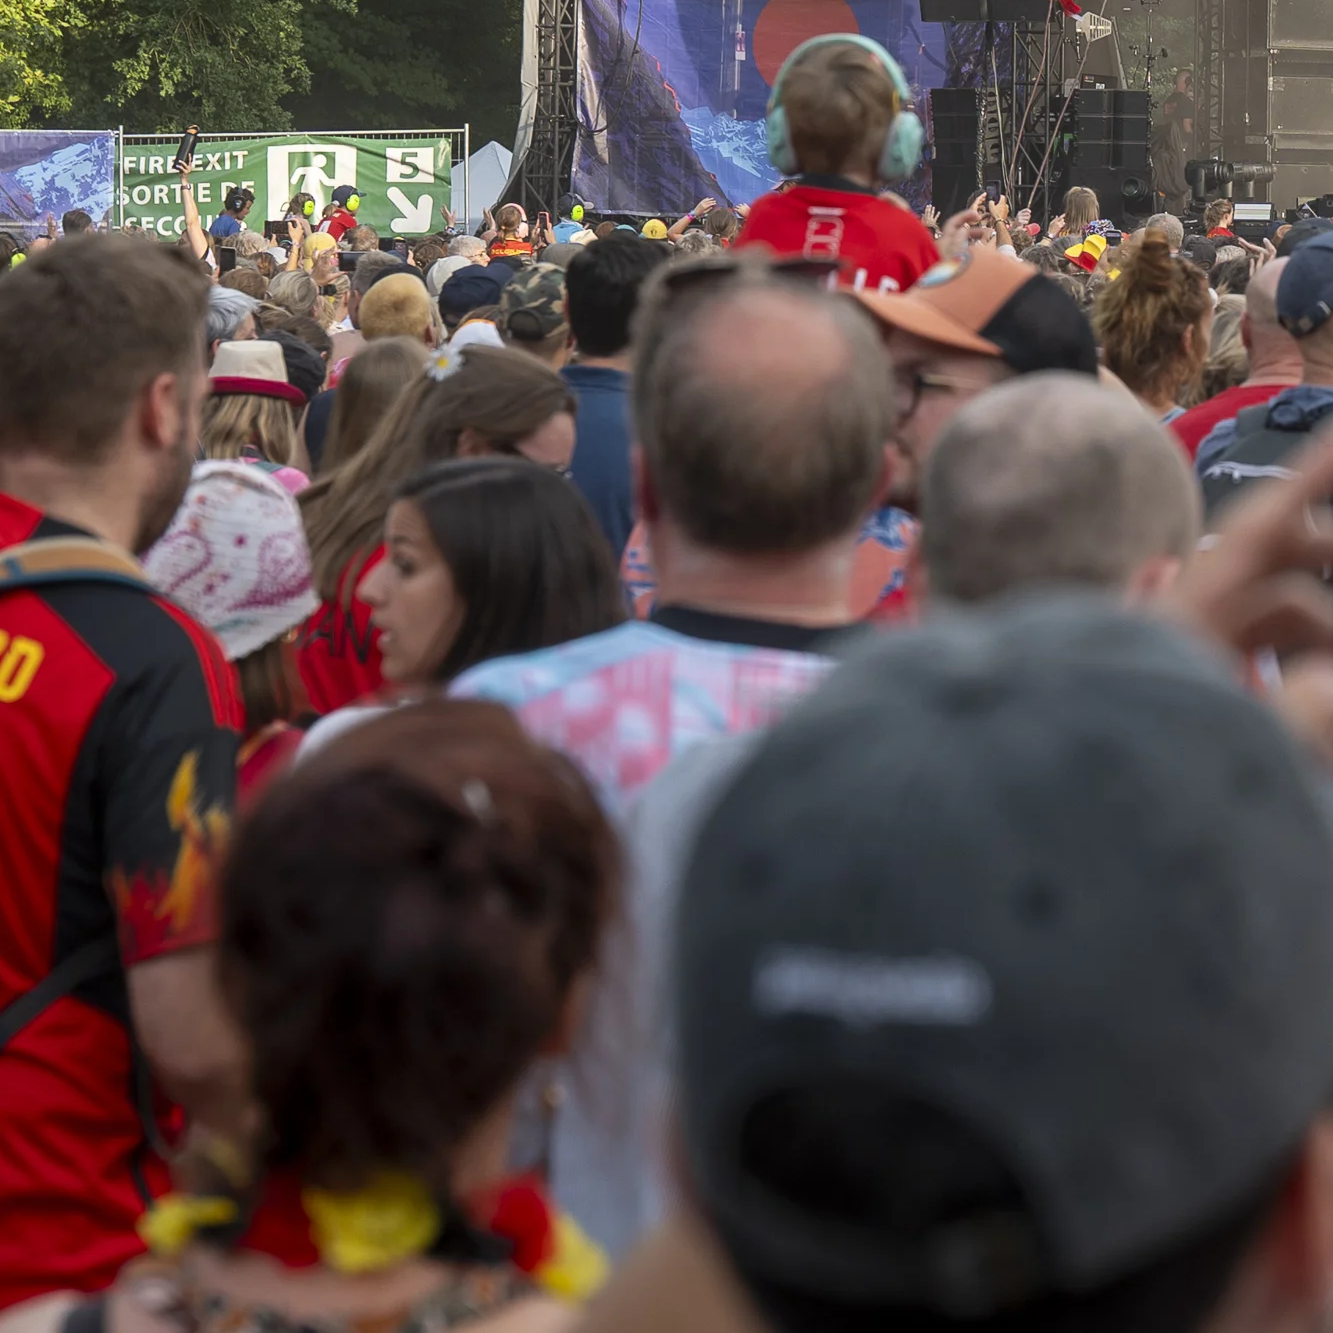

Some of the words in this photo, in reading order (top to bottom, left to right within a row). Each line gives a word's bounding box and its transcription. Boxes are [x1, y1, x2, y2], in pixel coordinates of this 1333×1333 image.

[123, 155, 182, 175] FIRE
[192, 150, 249, 172] EXIT
[399, 151, 420, 180] 5
